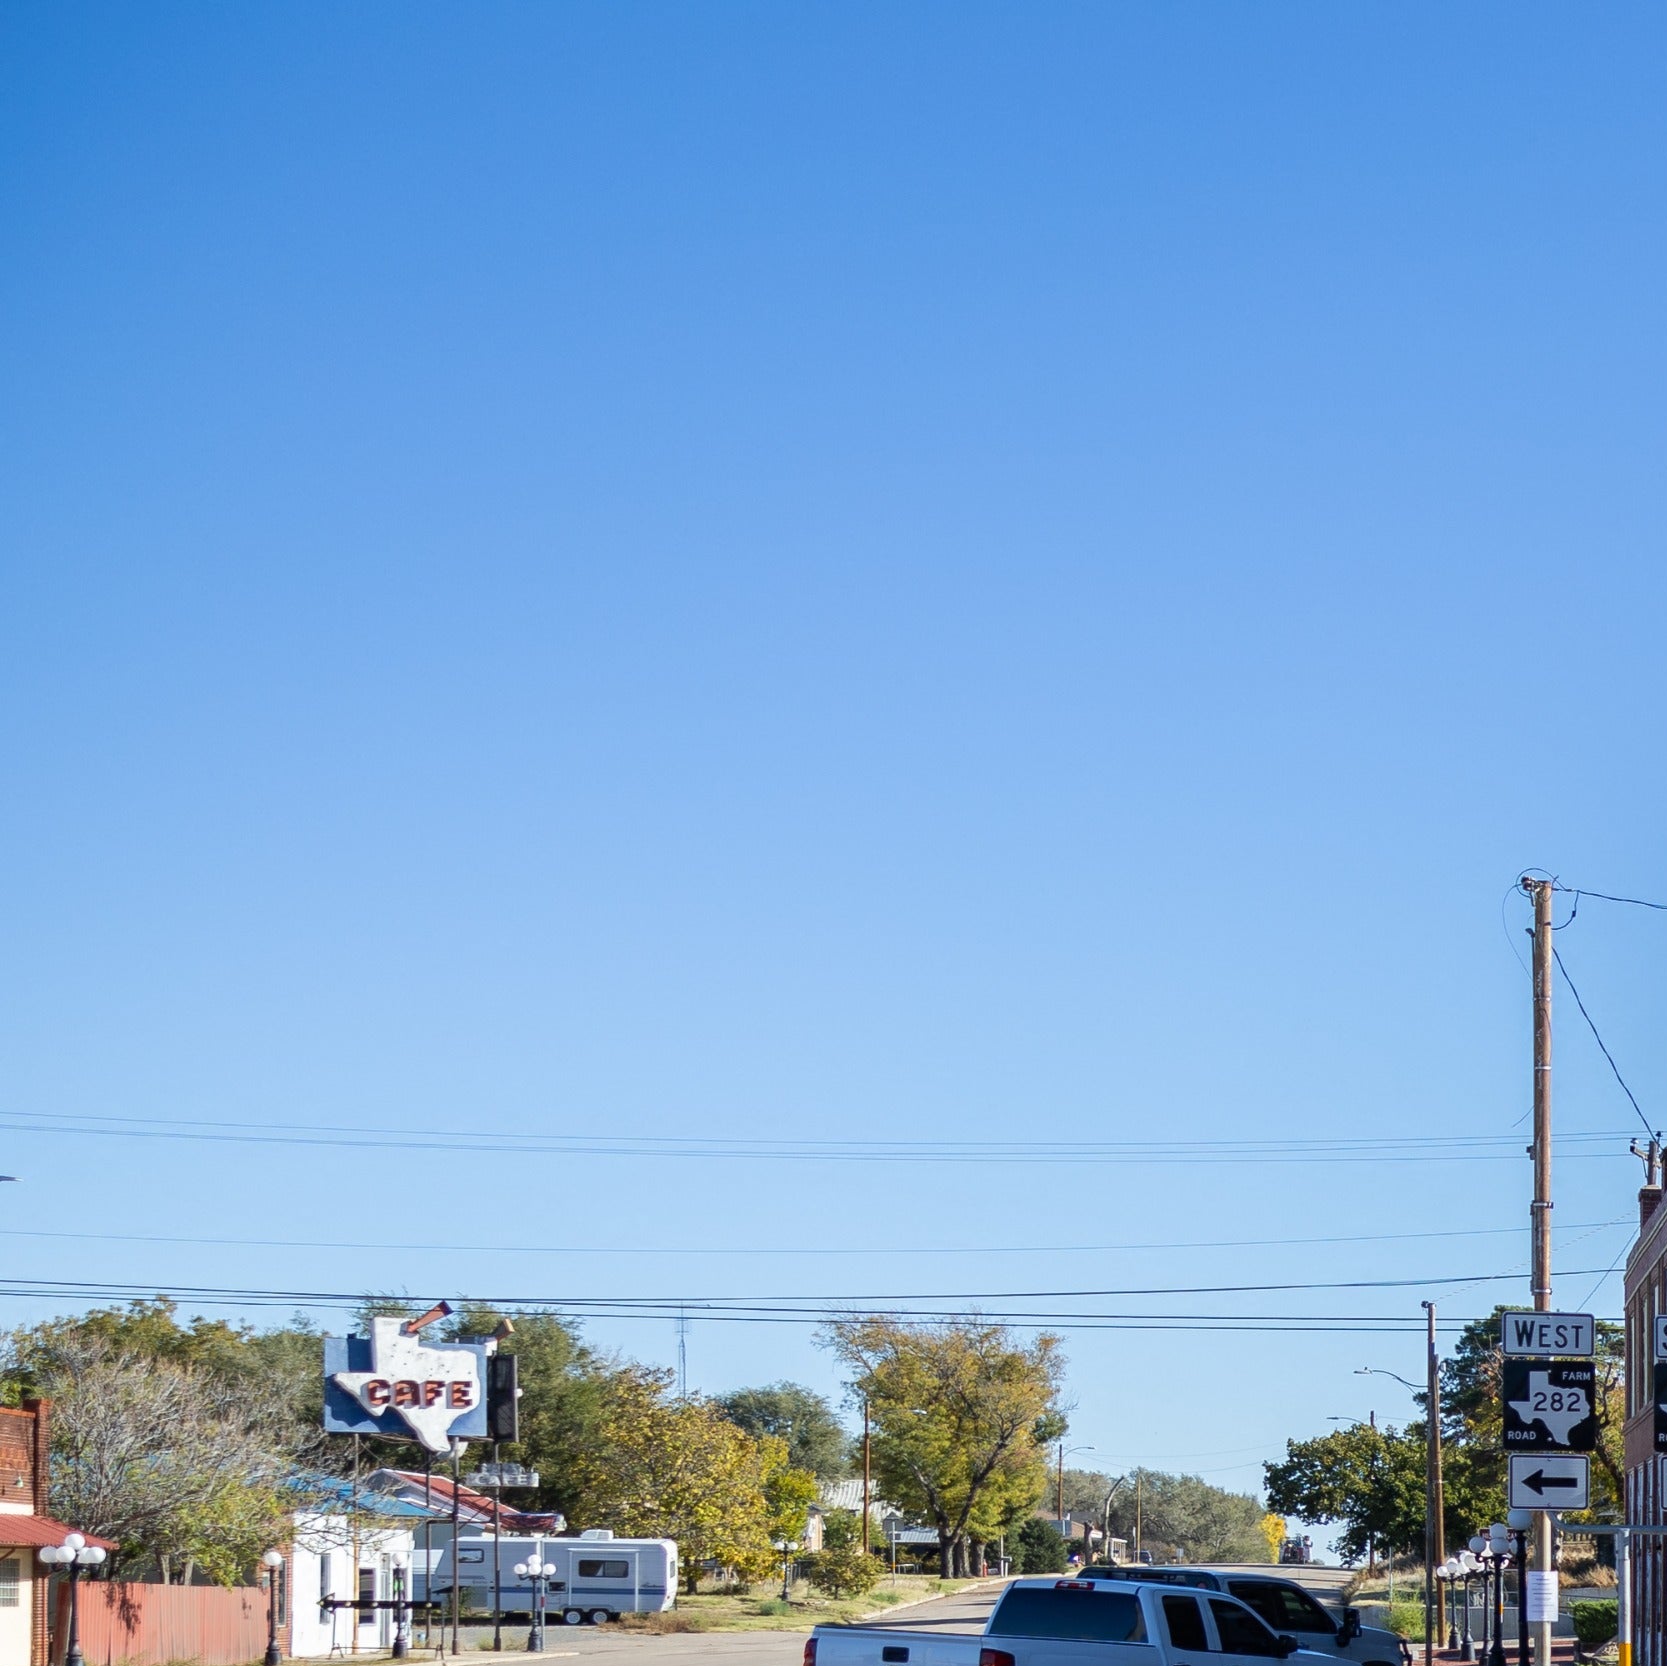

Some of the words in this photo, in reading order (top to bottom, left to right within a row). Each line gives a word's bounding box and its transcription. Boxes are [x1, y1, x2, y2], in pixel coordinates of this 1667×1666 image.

[1514, 1319, 1584, 1349] WEST
[1562, 1371, 1591, 1381] FARM
[365, 1379, 473, 1409] CAFE
[1532, 1391, 1581, 1412] 282
[1507, 1431, 1537, 1441] ROAD
